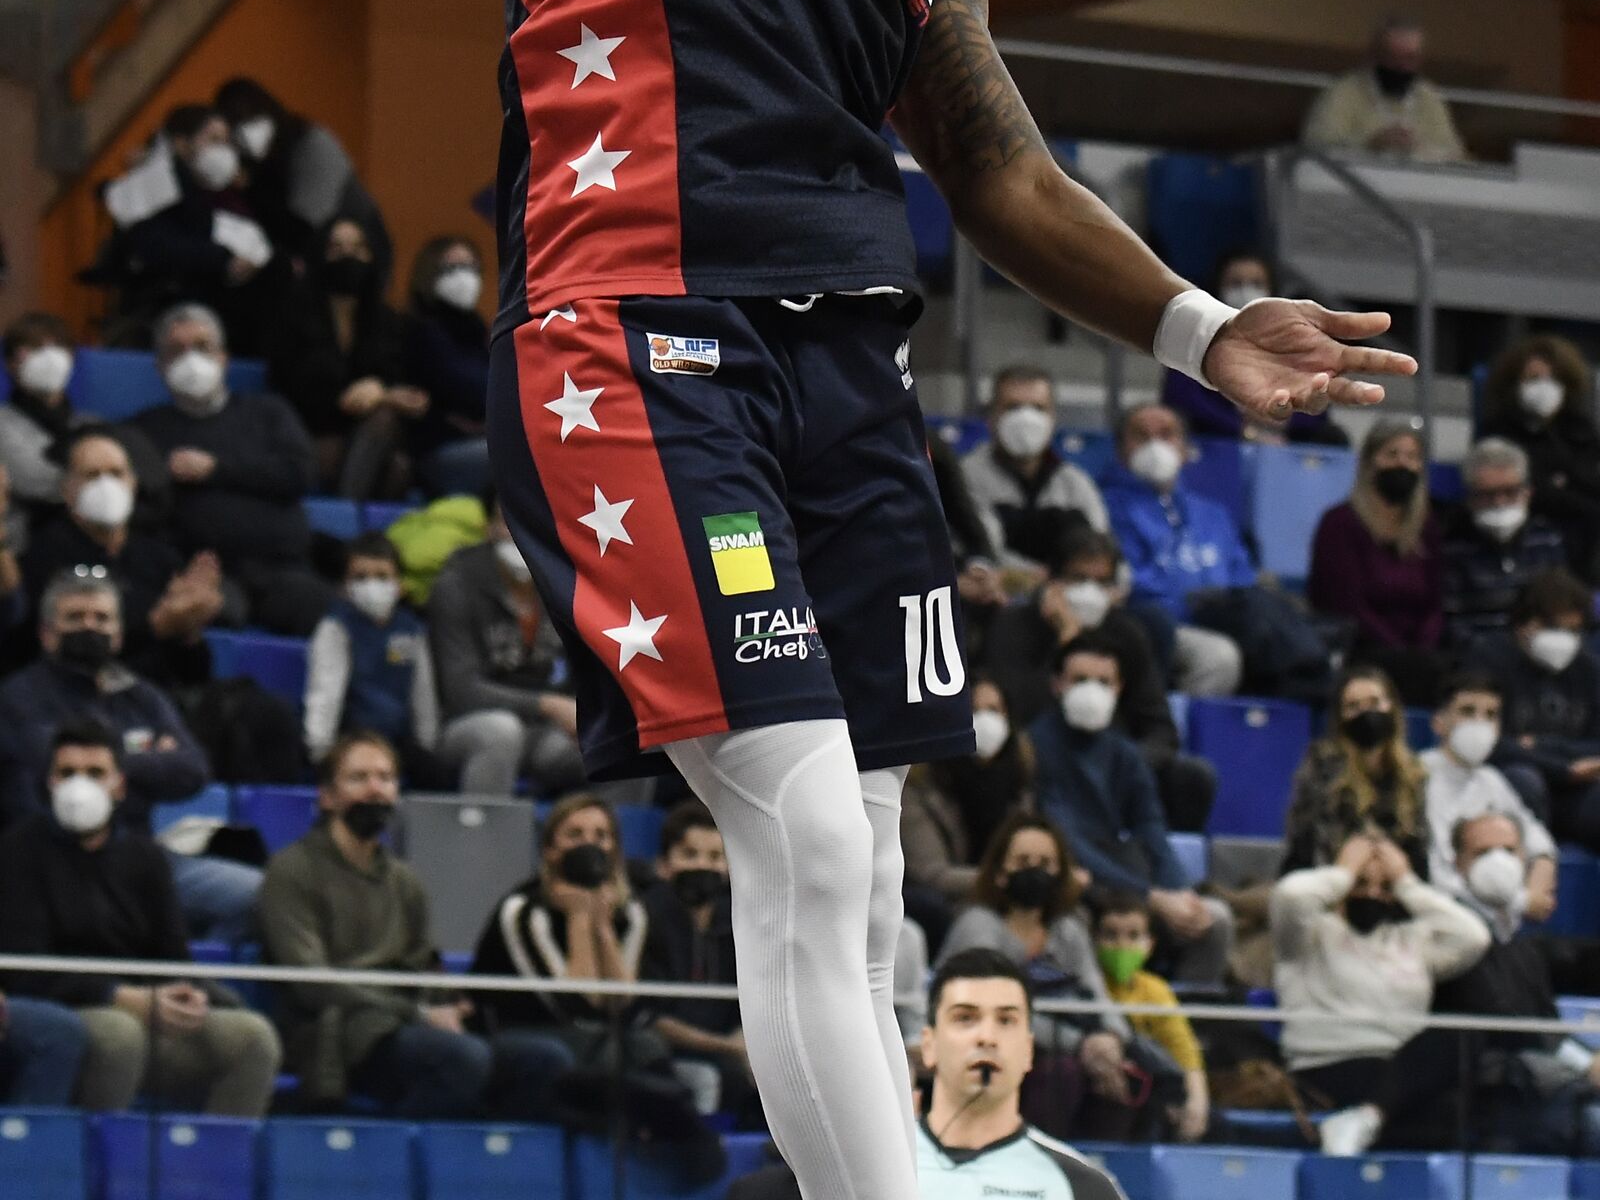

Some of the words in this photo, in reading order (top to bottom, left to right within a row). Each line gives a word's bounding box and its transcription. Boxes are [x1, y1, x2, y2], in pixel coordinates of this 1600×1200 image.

[654, 359, 670, 369] OLD
[709, 531, 765, 552] SIVAM
[735, 634, 808, 663] Chef
[900, 586, 966, 704] 10
